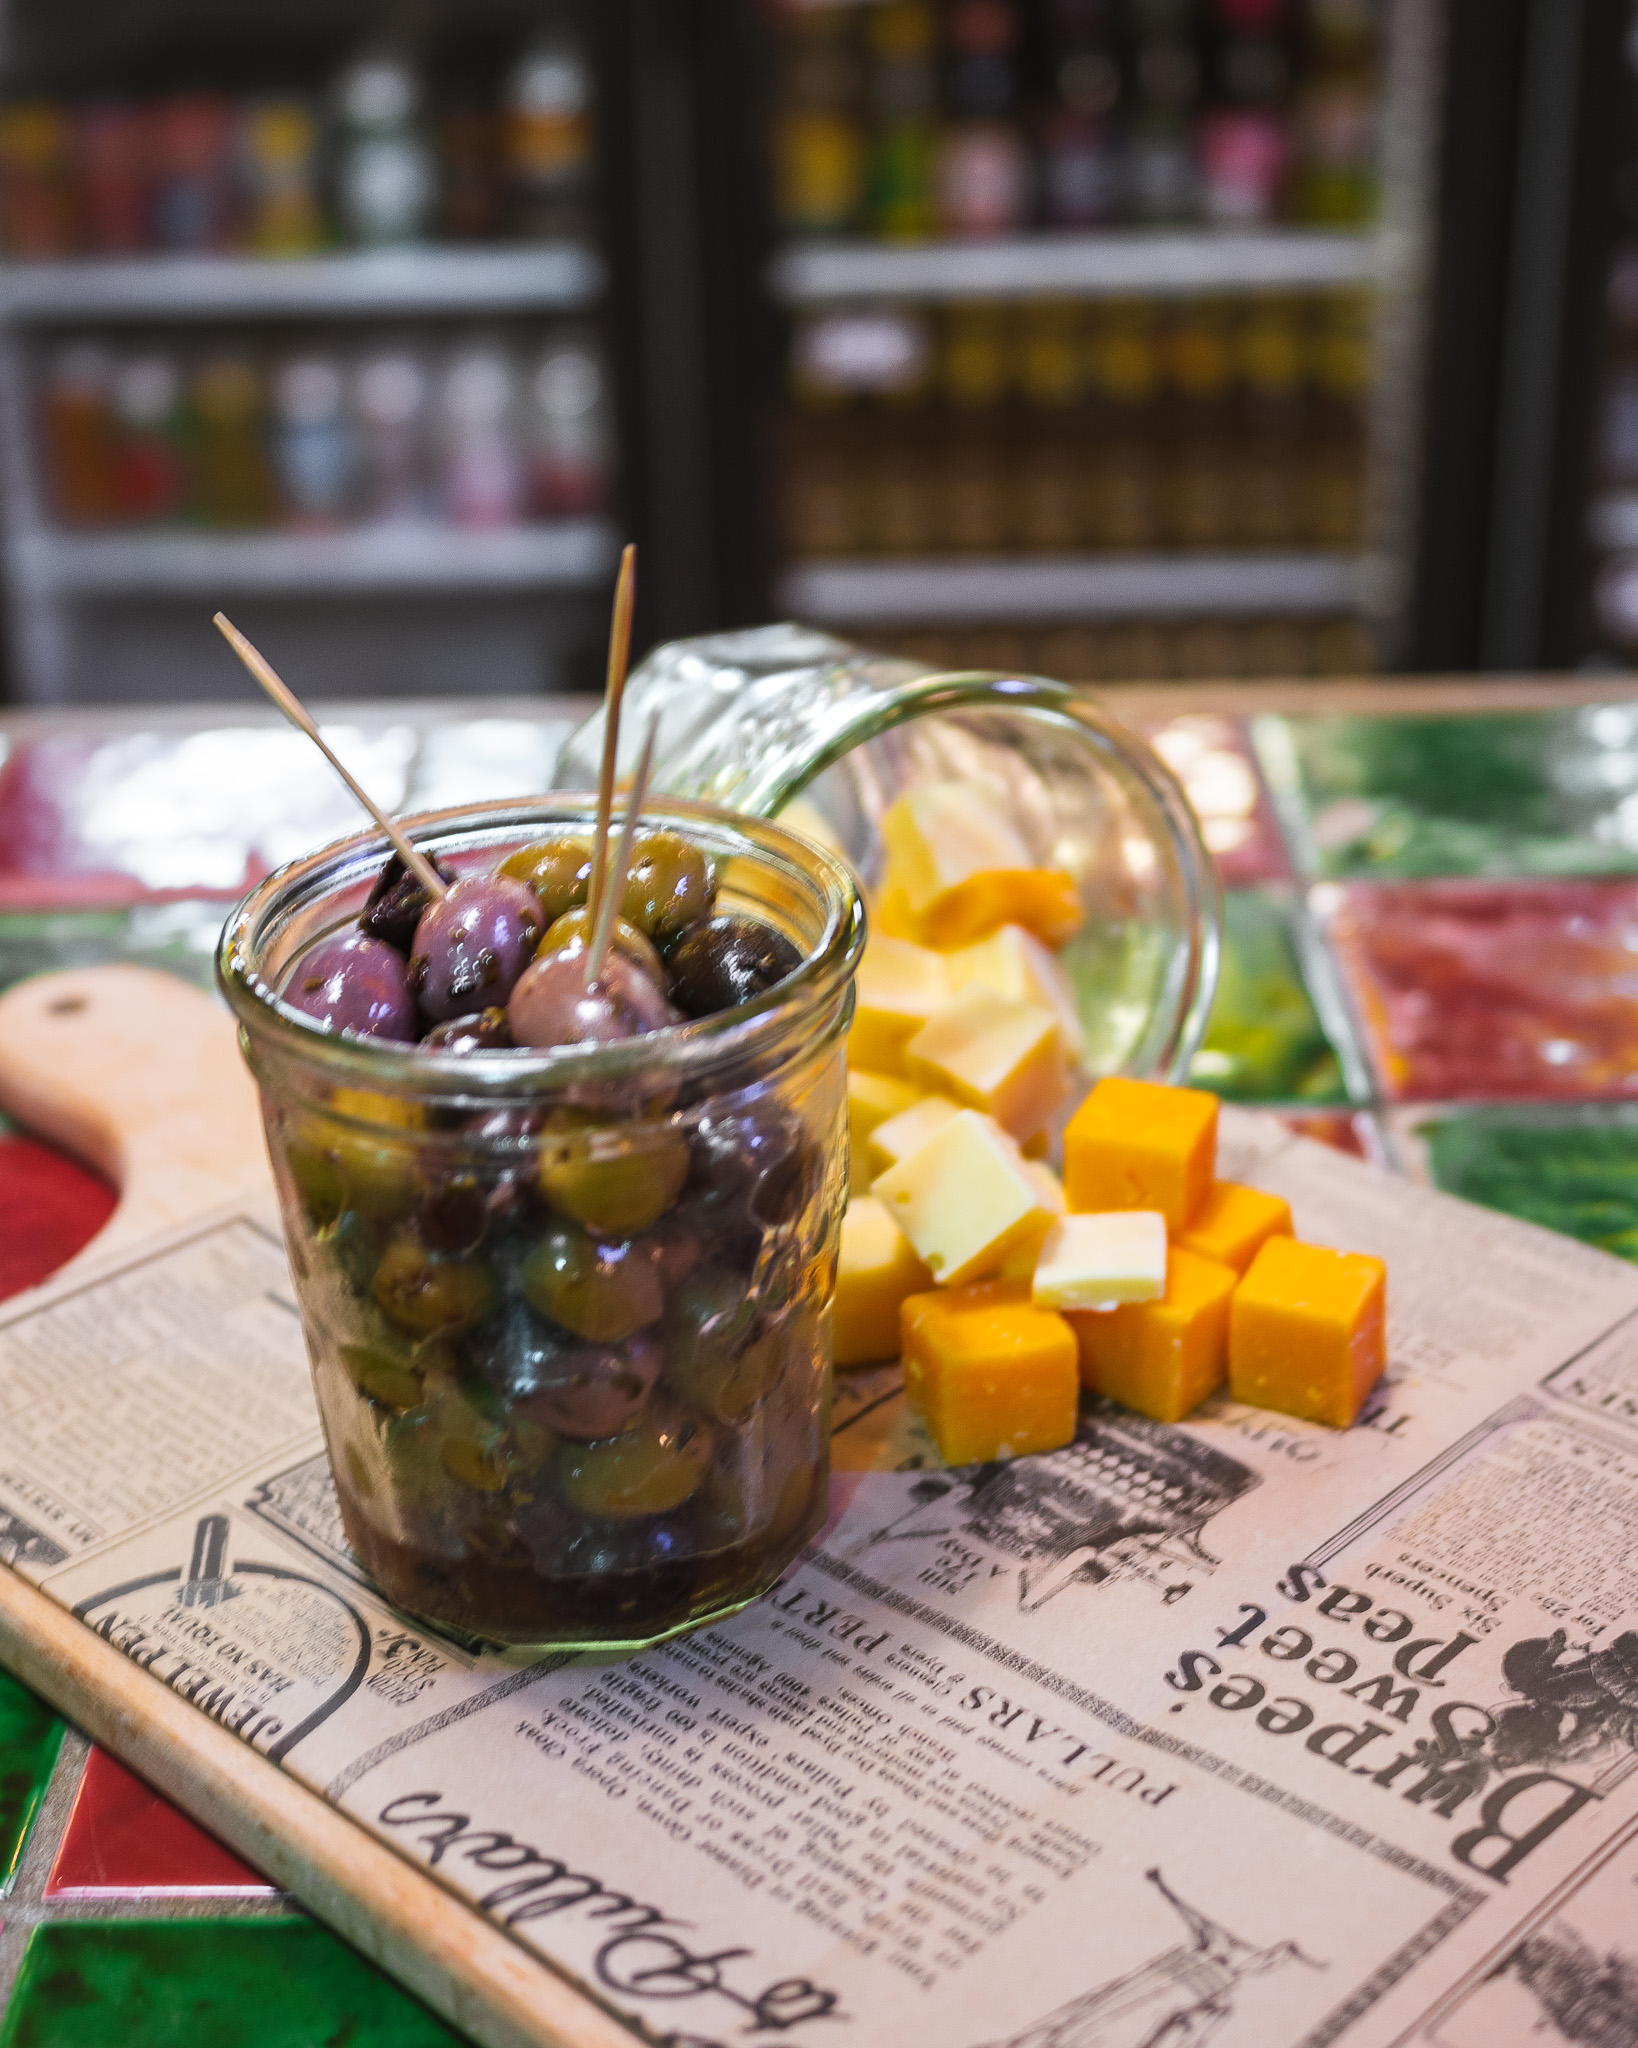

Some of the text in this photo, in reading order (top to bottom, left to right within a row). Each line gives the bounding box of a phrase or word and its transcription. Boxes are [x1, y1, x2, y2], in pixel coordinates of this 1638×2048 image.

[935, 1538, 1010, 1578] A Day
[1364, 1562, 1503, 1634] Six Superb
[1397, 1552, 1508, 1613] Spencers
[780, 1626, 824, 1653] direct
[1276, 1563, 1481, 1686] Peas
[1570, 1613, 1608, 1636] For
[211, 1639, 255, 1665] NO
[403, 1647, 449, 1675] PEN
[701, 1630, 774, 1674] Agencies
[818, 1647, 853, 1669] sent
[898, 1642, 949, 1673] Dyers
[92, 1611, 284, 1738] JEWEL PEN
[240, 1657, 297, 1692] HAS
[593, 1669, 667, 1714] fragile
[696, 1666, 717, 1680] to
[727, 1664, 758, 1684] are
[771, 1671, 813, 1697] 4000
[849, 1664, 896, 1693] orders
[881, 1653, 955, 1697] Cleaners
[1214, 1603, 1496, 1758] Sweet
[710, 1675, 769, 1710] shades
[754, 1680, 818, 1718] returns
[890, 1689, 917, 1707] all
[551, 1697, 632, 1746] delicate
[661, 1708, 699, 1733] too
[704, 1705, 774, 1747] expert
[763, 1703, 806, 1730] pale
[814, 1696, 875, 1733] Pullars
[814, 1715, 847, 1735] and
[935, 1712, 977, 1738] paid
[507, 1720, 572, 1760] Cloak
[529, 1710, 607, 1758] Frock,
[693, 1728, 719, 1746] is
[797, 1723, 845, 1753] Dyed
[894, 1724, 958, 1762] Branch
[955, 1680, 1182, 1813] PULLARS
[630, 1743, 708, 1791] dainty,
[677, 1747, 704, 1765] is
[716, 1742, 812, 1799] condition
[845, 1733, 926, 1780] moderate
[1163, 1650, 1604, 1886] Burpee's
[562, 1757, 633, 1801] Opera
[597, 1752, 699, 1814] Dancing
[705, 1760, 787, 1809] process
[872, 1767, 927, 1800] Shoes
[690, 1810, 726, 1833] or
[704, 1790, 758, 1824] such
[808, 1793, 869, 1831] good
[781, 1808, 855, 1853] Pullar
[720, 1831, 795, 1877] Dress
[792, 1840, 897, 1903] Cleaning
[791, 1872, 852, 1909] Ball
[378, 1792, 852, 2034] to Pullars
